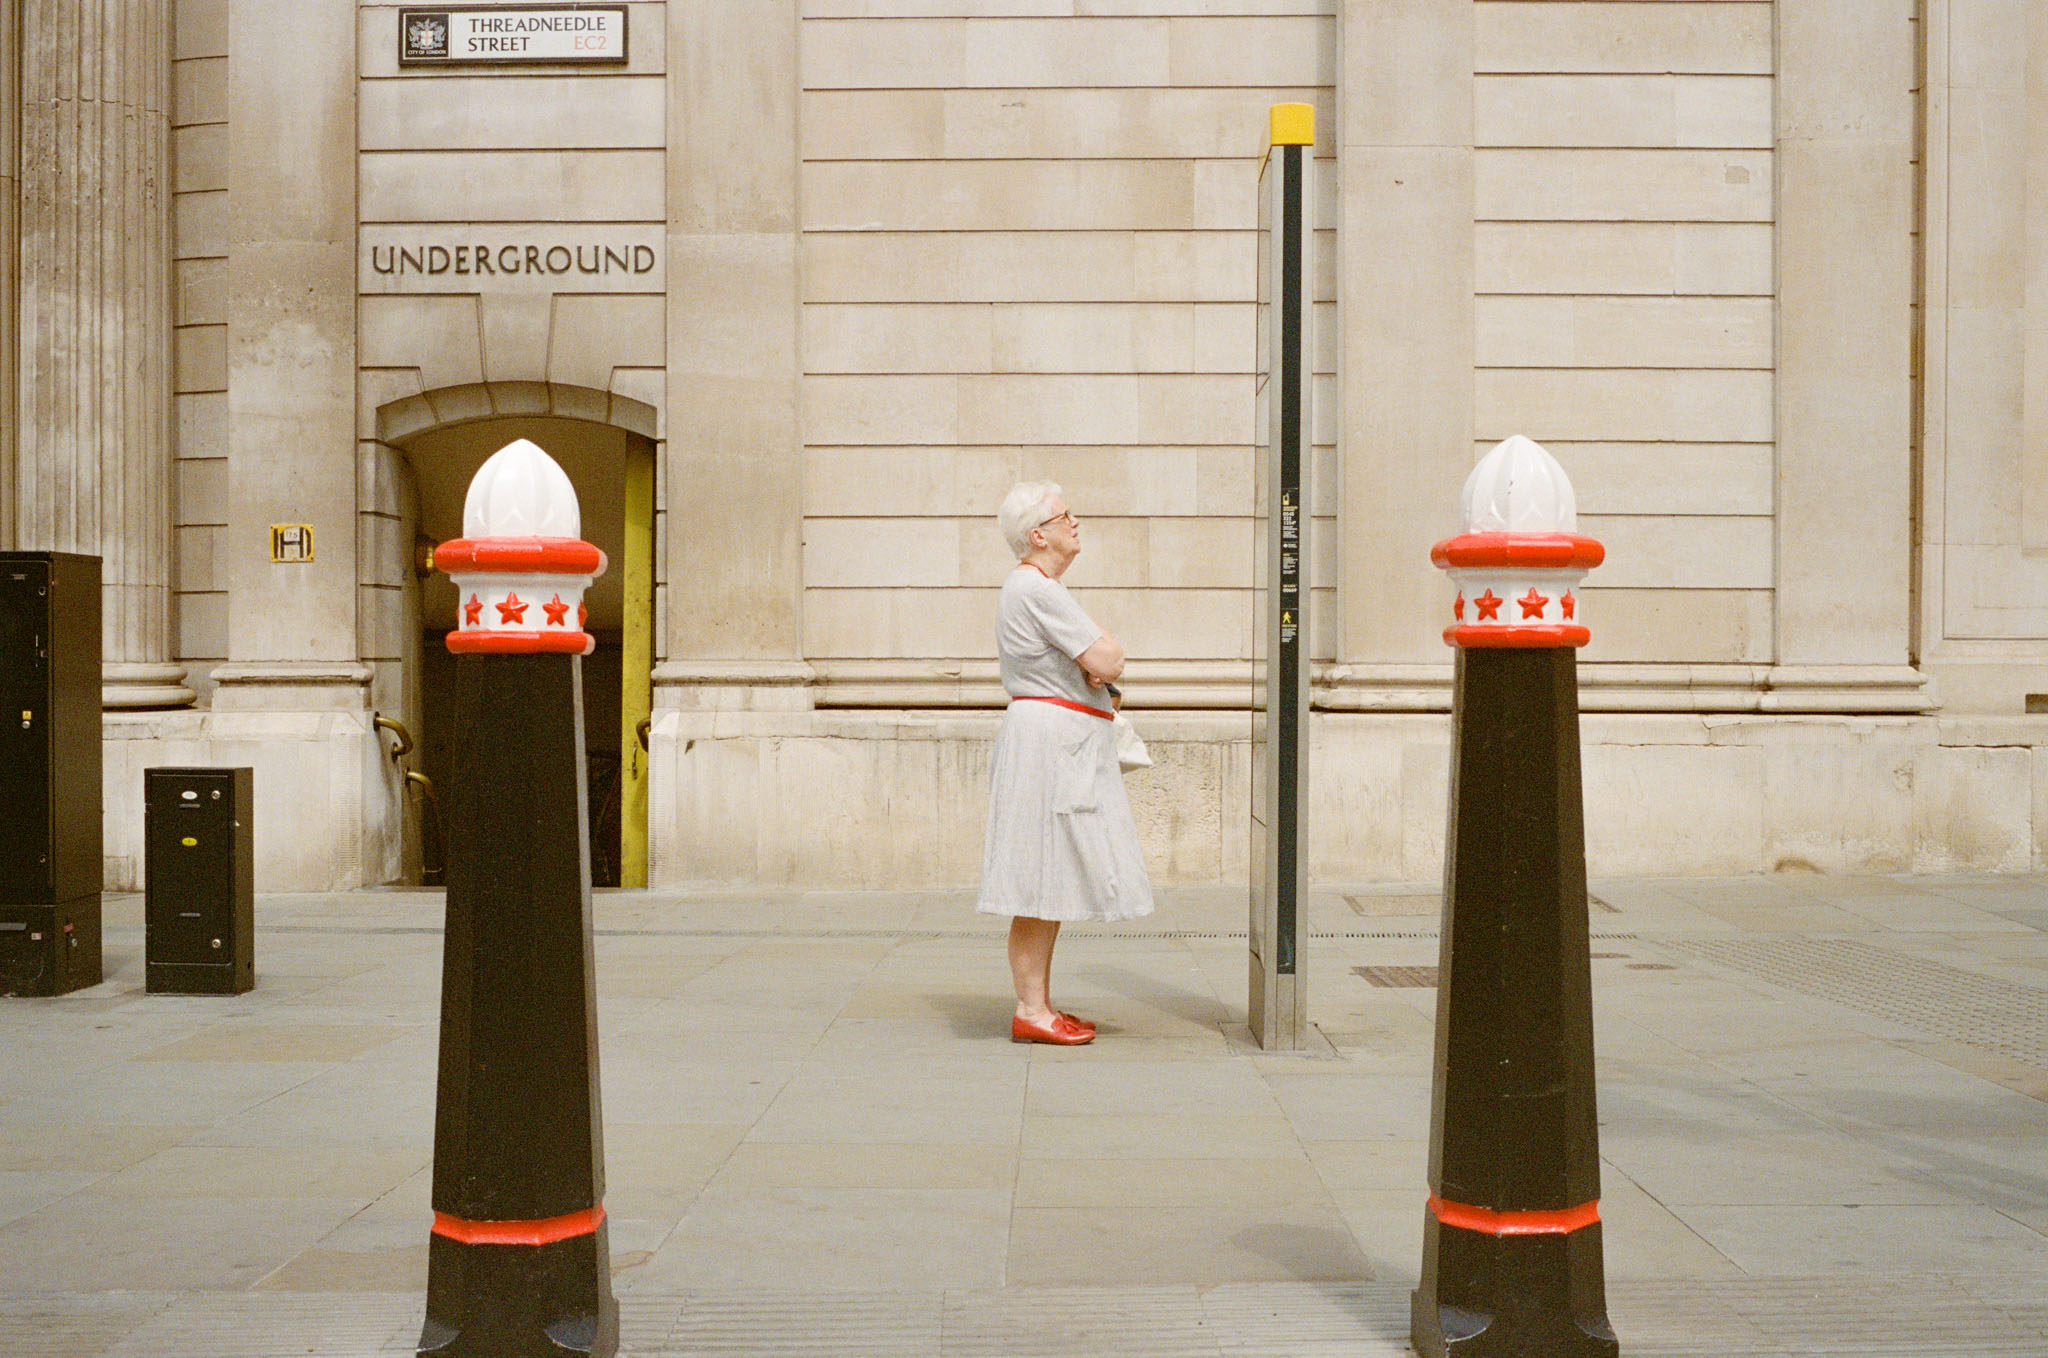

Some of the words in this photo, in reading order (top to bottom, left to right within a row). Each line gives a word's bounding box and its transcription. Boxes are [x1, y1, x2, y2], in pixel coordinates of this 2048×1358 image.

[469, 17, 607, 33] THREADNEEDLE
[468, 37, 530, 51] STREET
[574, 35, 607, 50] EC2
[372, 245, 656, 275] UNDERGROUND
